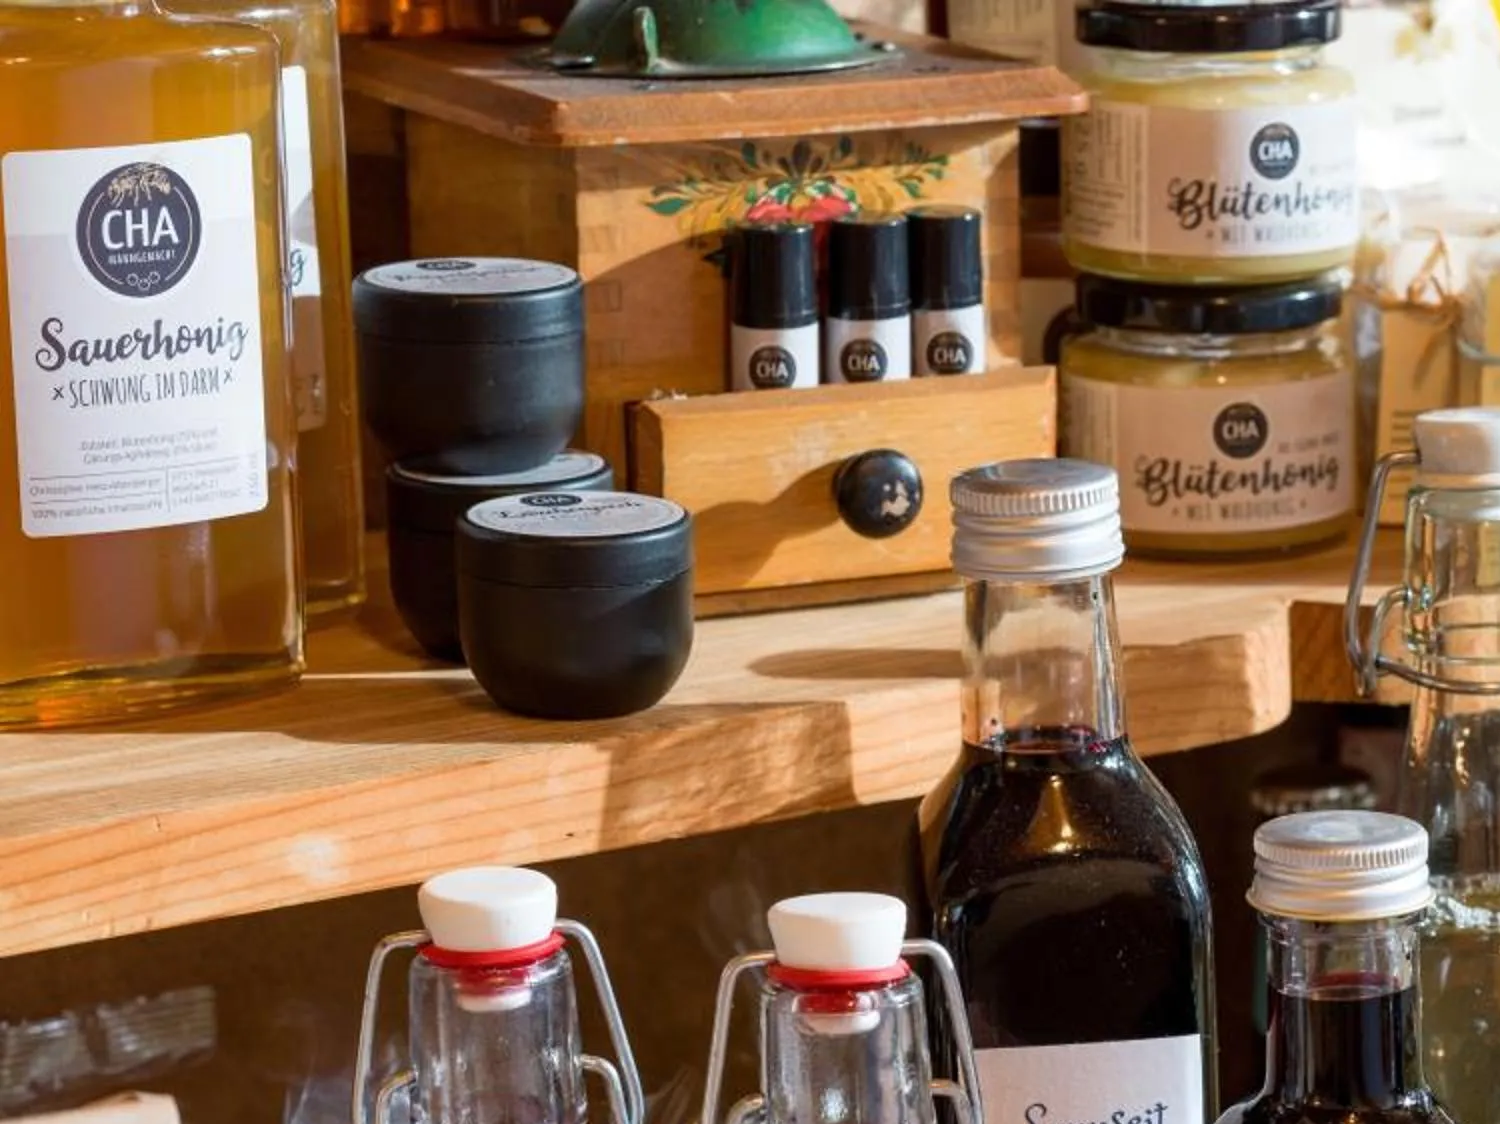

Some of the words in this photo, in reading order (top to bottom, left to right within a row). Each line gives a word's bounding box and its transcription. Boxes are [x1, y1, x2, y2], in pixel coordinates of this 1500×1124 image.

[1258, 140, 1293, 160] CHA
[101, 206, 180, 249] CHA
[35, 316, 249, 373] Sauerhonig
[848, 355, 880, 370] CHA
[934, 348, 966, 364] CHA
[756, 362, 788, 378] CHA
[69, 374, 150, 409] SCHWUNG
[156, 372, 175, 401] IM
[179, 366, 220, 397] DARM
[1222, 420, 1259, 440] CHA
[1135, 454, 1339, 507] Blütenhonig
